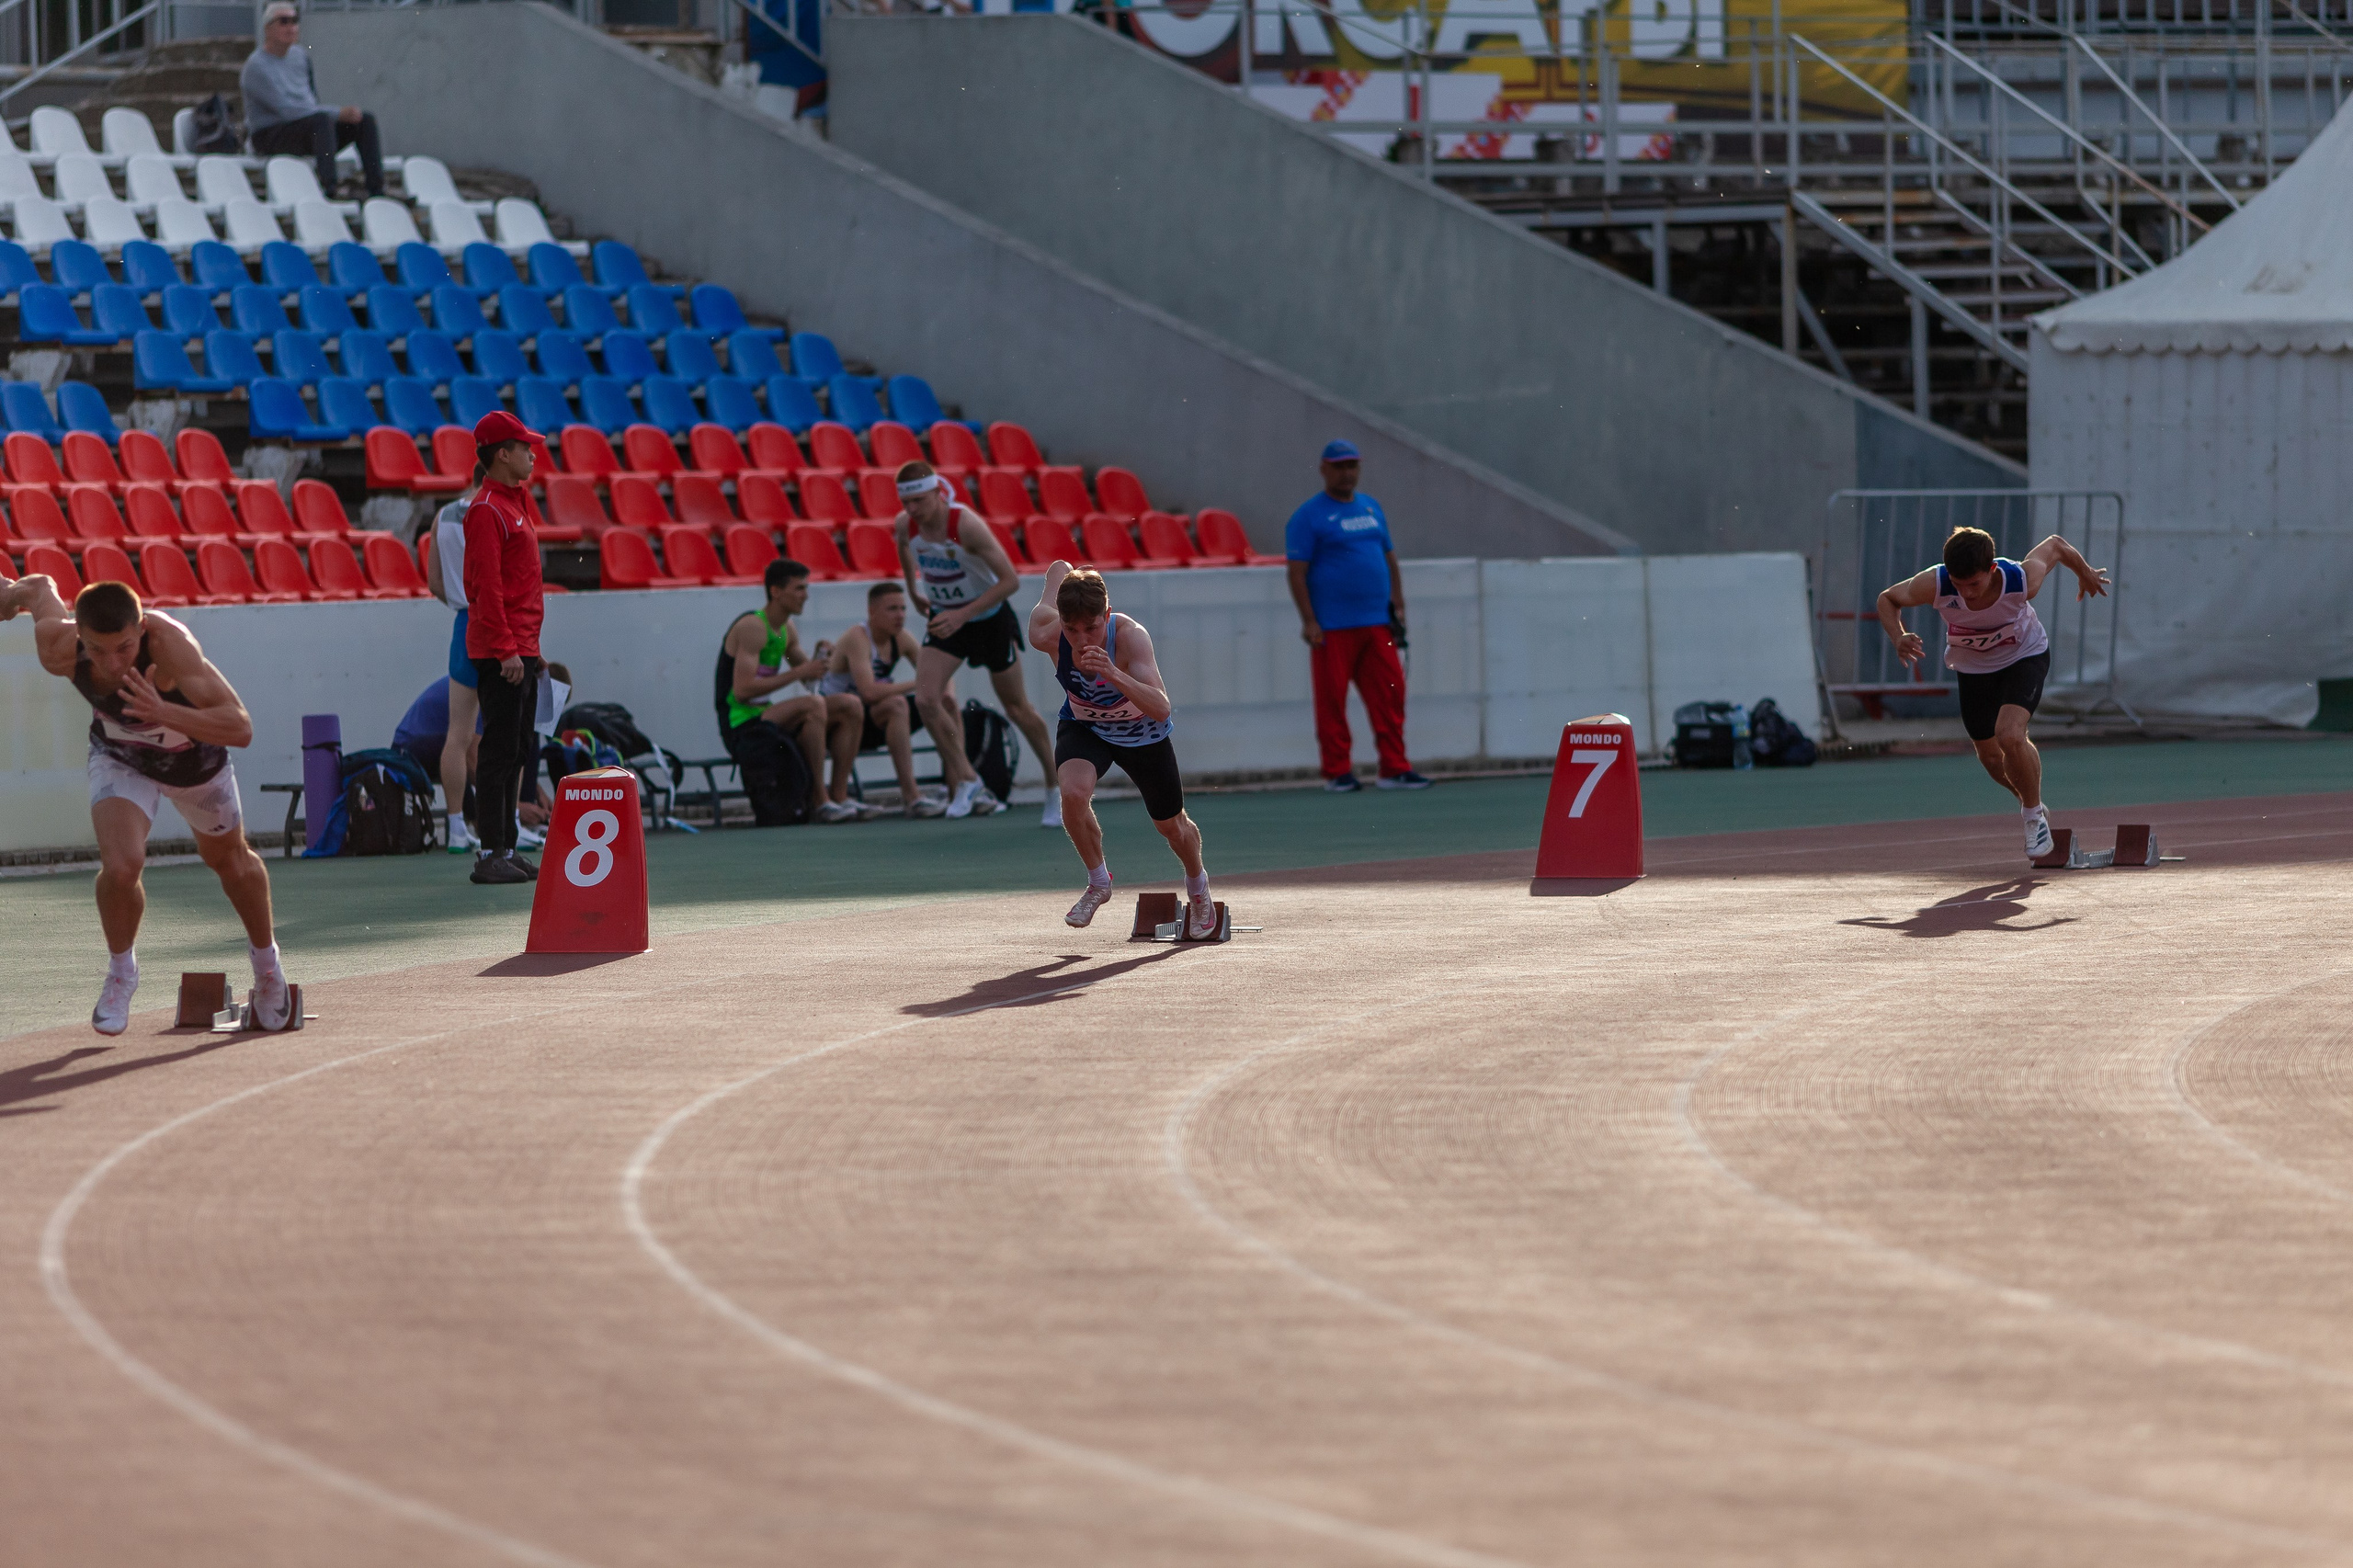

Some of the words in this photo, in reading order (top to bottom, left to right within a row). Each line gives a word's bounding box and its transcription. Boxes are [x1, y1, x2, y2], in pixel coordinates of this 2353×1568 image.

[930, 585, 964, 600] 114
[1961, 632, 2002, 647] 274
[1083, 708, 1132, 720] 262
[1569, 733, 1622, 745] MONDO
[1568, 749, 1619, 818] 7
[564, 789, 624, 801] MONDO
[564, 809, 620, 887] 8
